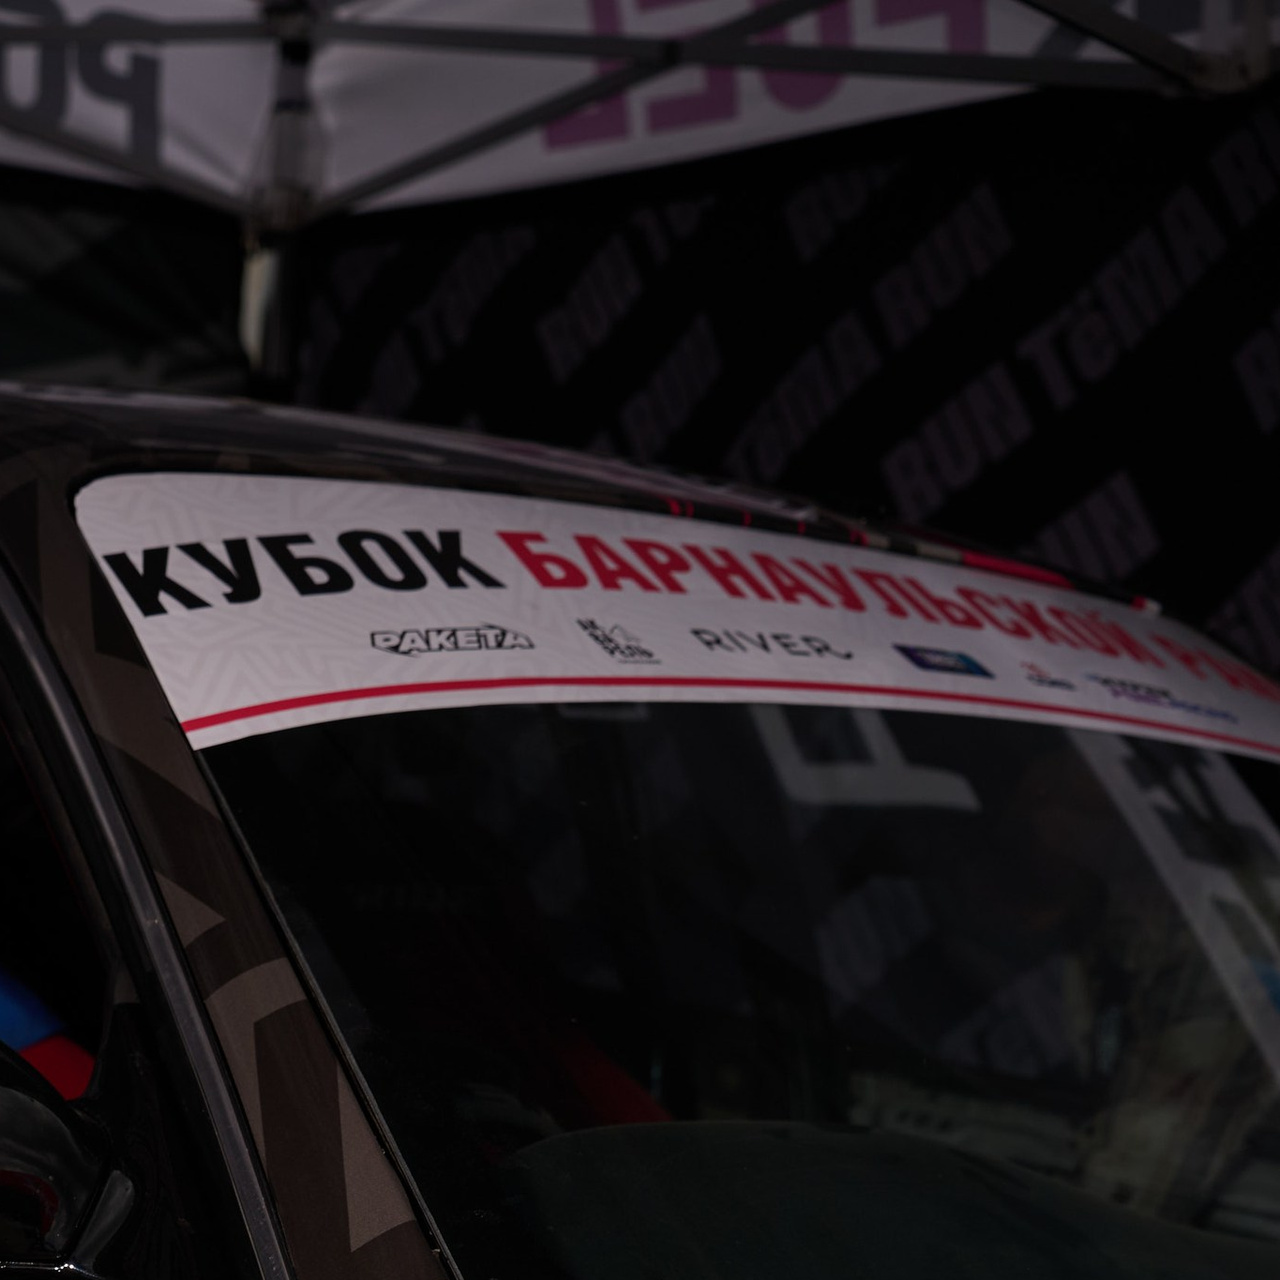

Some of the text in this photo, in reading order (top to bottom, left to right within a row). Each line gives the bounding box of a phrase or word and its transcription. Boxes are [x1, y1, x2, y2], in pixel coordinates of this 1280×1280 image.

[872, 179, 1016, 351] RUN
[880, 361, 1036, 527] RUN
[104, 529, 506, 618] КУБОК
[497, 530, 1168, 672] БАРНАУЛЬСКОЙ
[689, 626, 855, 662] RIVER
